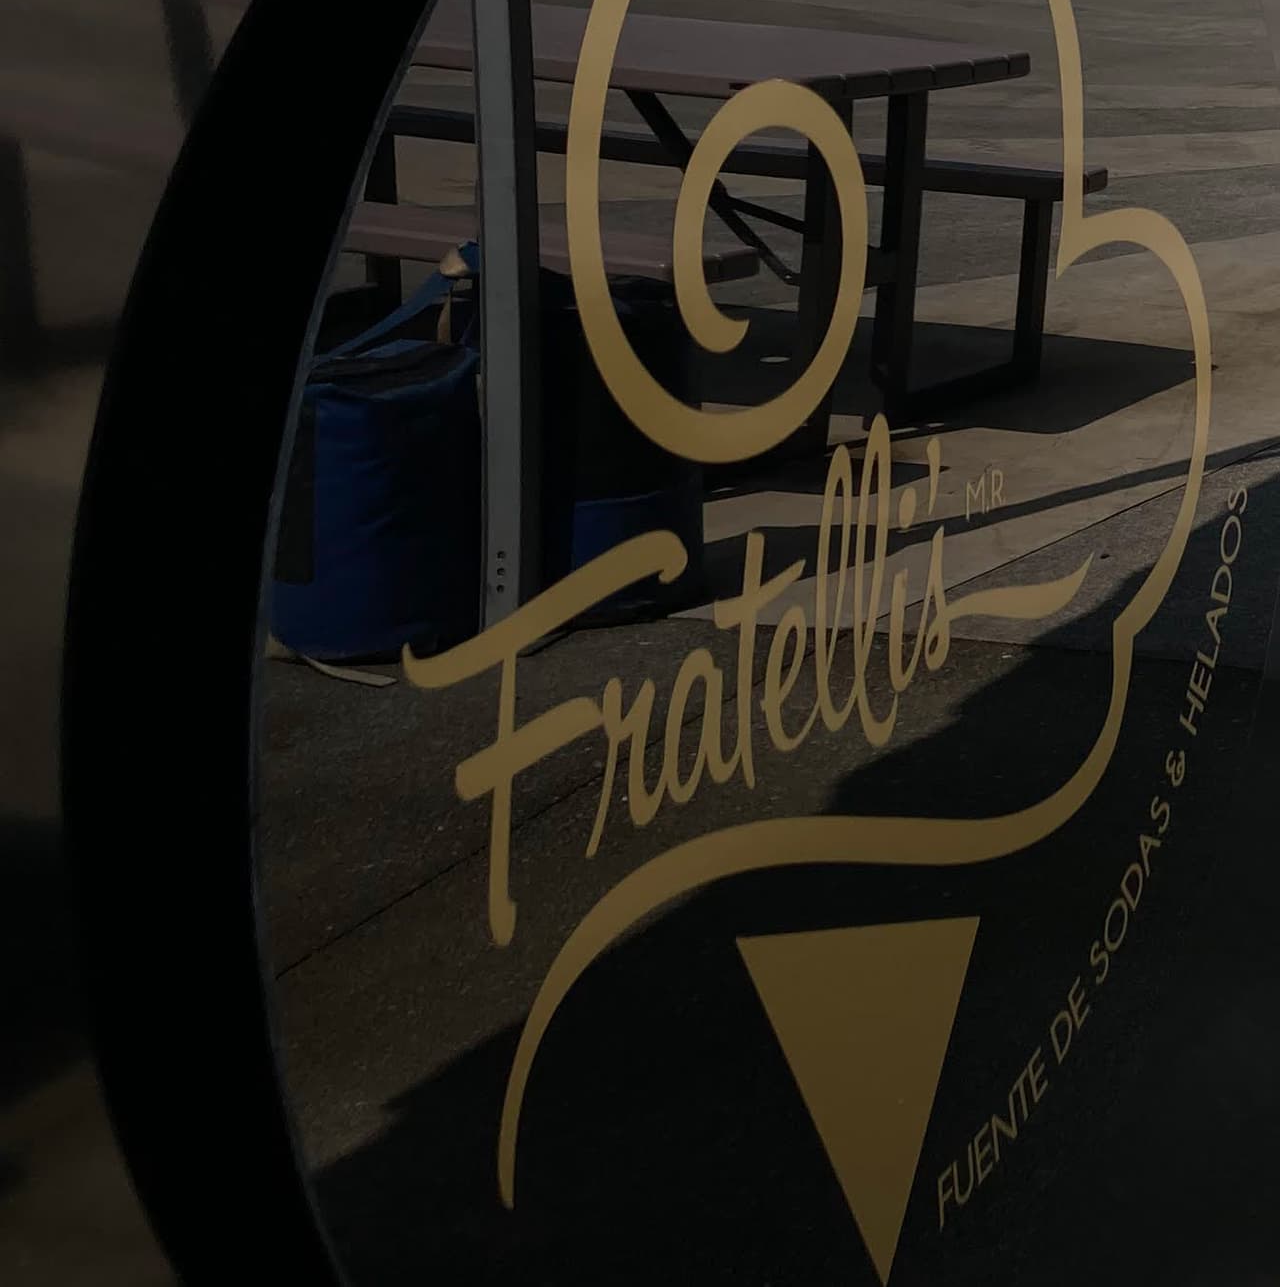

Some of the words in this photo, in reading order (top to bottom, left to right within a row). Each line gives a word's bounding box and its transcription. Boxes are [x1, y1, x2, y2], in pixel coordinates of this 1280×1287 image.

[937, 1046, 1049, 1233] FUENTE
[1050, 975, 1091, 1064] DE
[1090, 796, 1171, 985] SODAS
[1165, 749, 1186, 787] &
[1179, 487, 1248, 735] HELADOS
